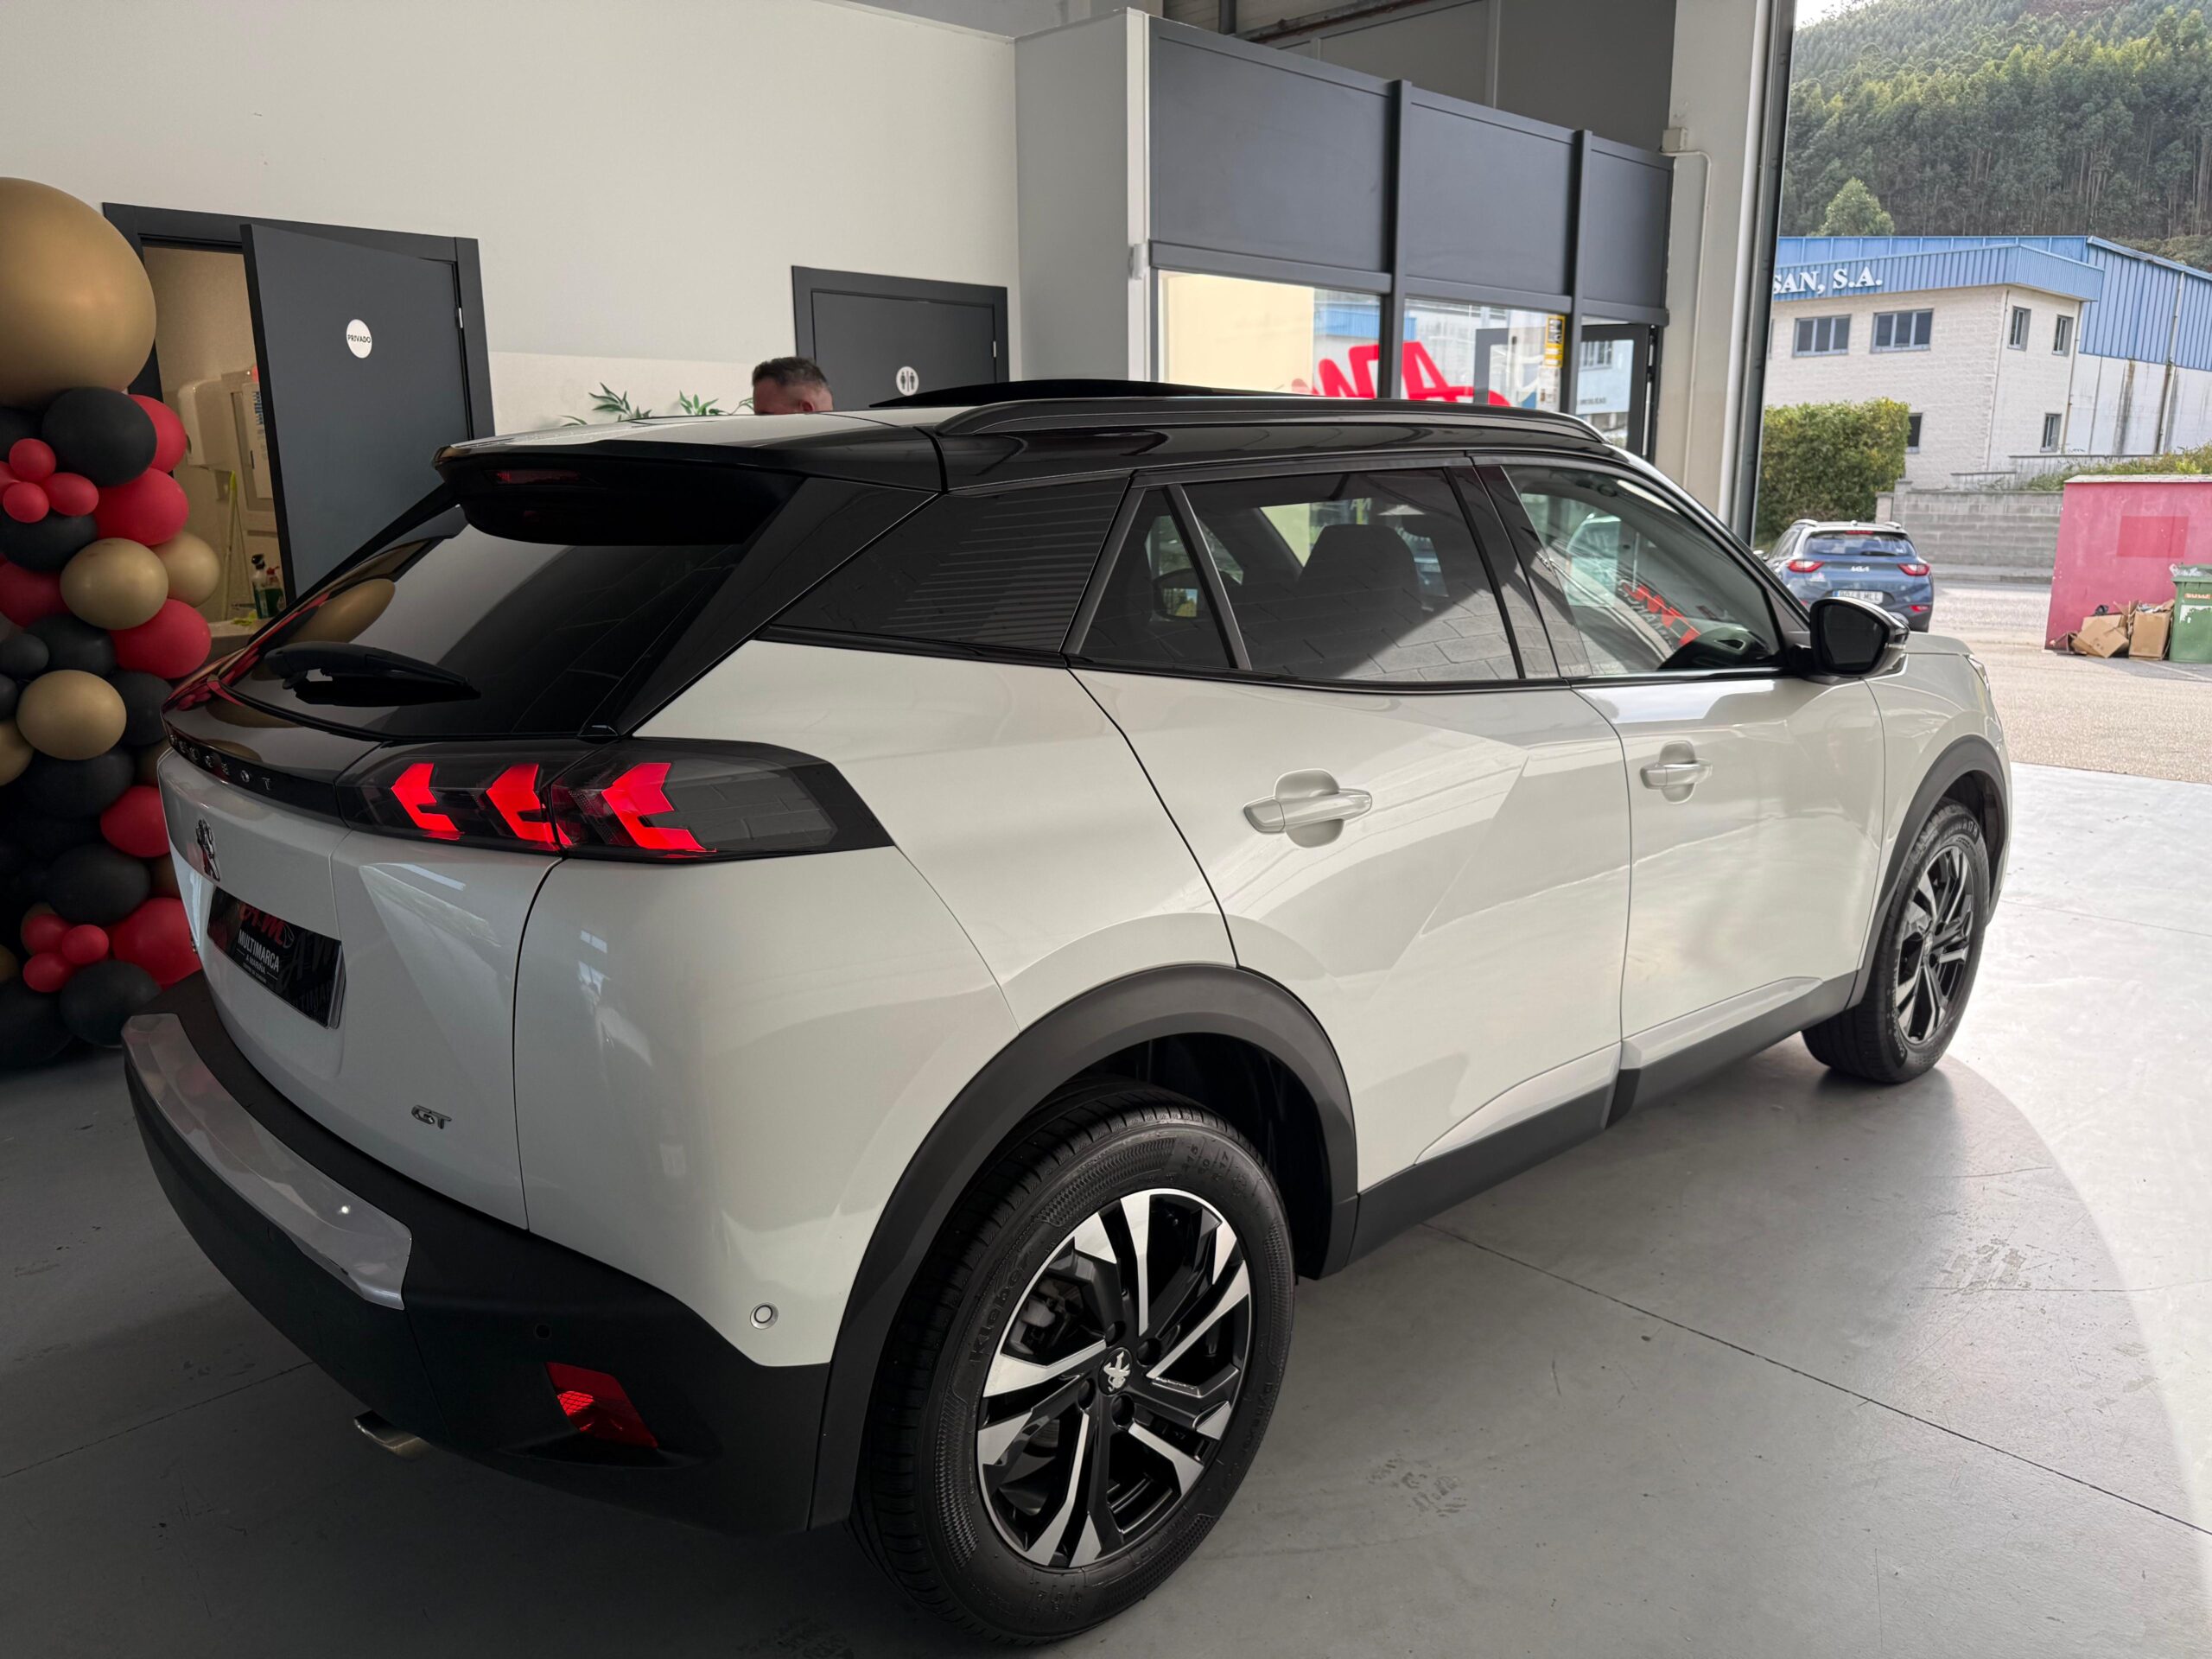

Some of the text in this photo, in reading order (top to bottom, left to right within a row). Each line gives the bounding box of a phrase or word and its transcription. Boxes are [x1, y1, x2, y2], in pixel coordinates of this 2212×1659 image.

[1833, 265, 1884, 289] S.A.
[347, 334, 372, 344] PRIVADO
[169, 734, 271, 791] PEUGEOT
[238, 929, 279, 973] MULTIMARCA
[411, 1104, 452, 1129] GT
